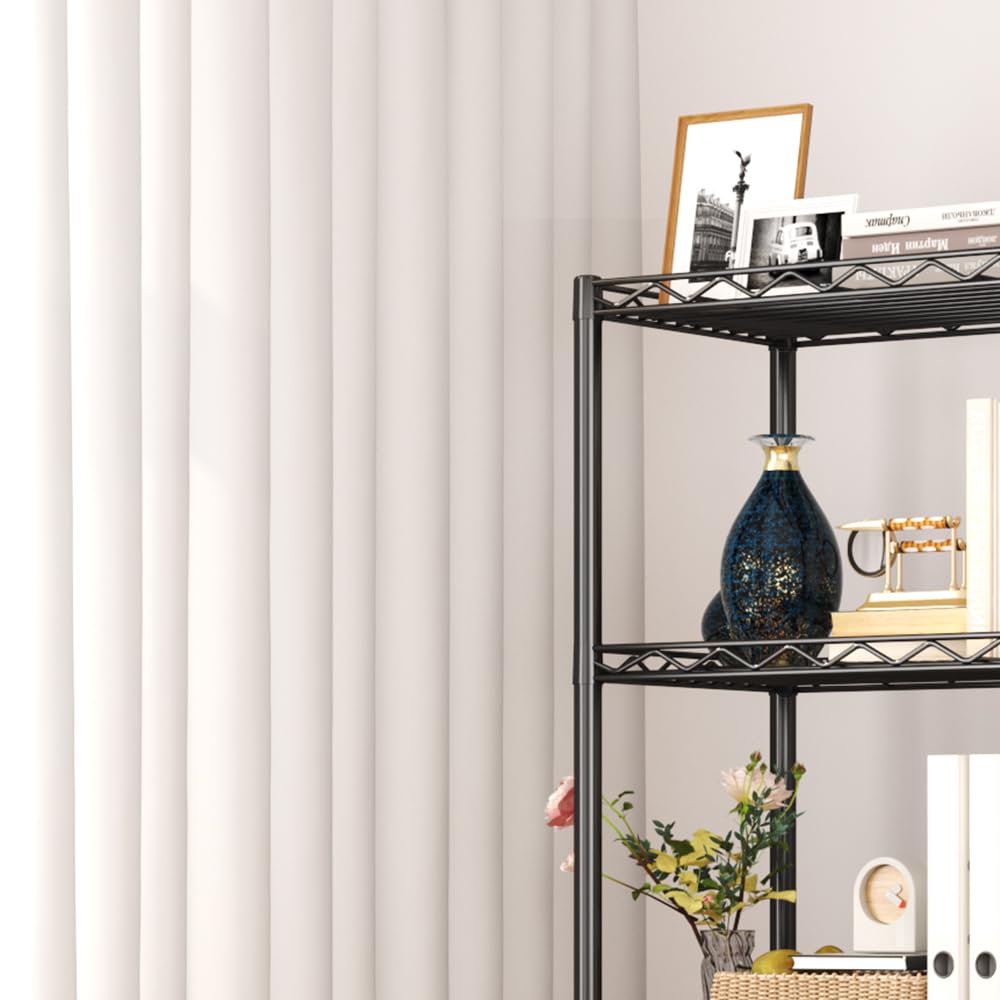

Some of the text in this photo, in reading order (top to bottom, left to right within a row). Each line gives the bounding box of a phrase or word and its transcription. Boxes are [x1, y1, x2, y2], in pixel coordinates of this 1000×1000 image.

[864, 212, 911, 228] Спартак
[871, 237, 949, 254] Мартин Иден
